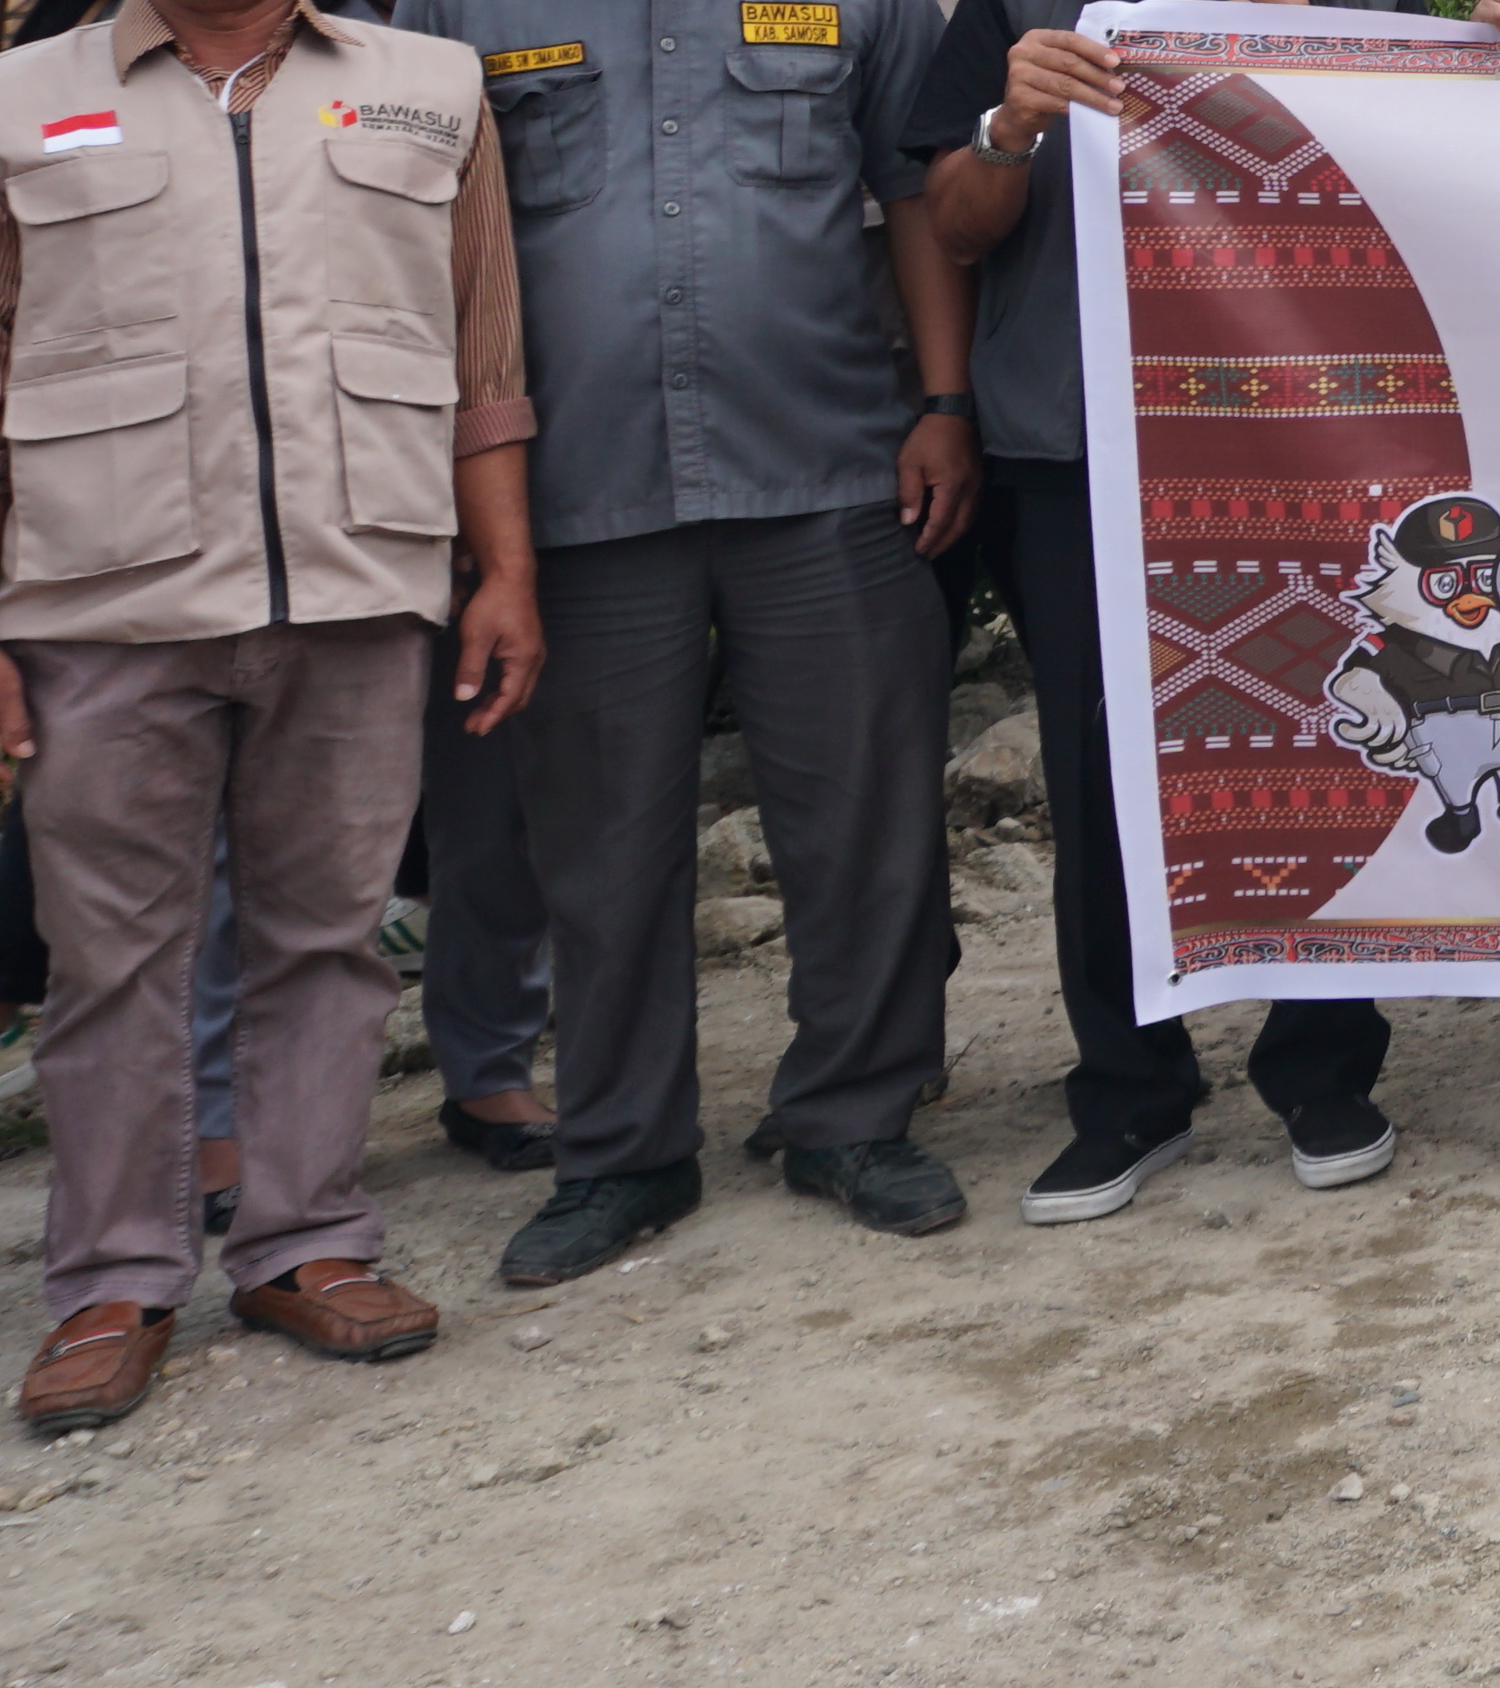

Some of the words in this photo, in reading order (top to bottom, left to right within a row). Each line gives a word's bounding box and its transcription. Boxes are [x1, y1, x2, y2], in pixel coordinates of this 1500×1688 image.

[746, 4, 833, 22] BAWASLU
[754, 25, 779, 41] KAB.
[784, 26, 829, 43] SAMOSIR
[359, 103, 461, 131] BAWASLU
